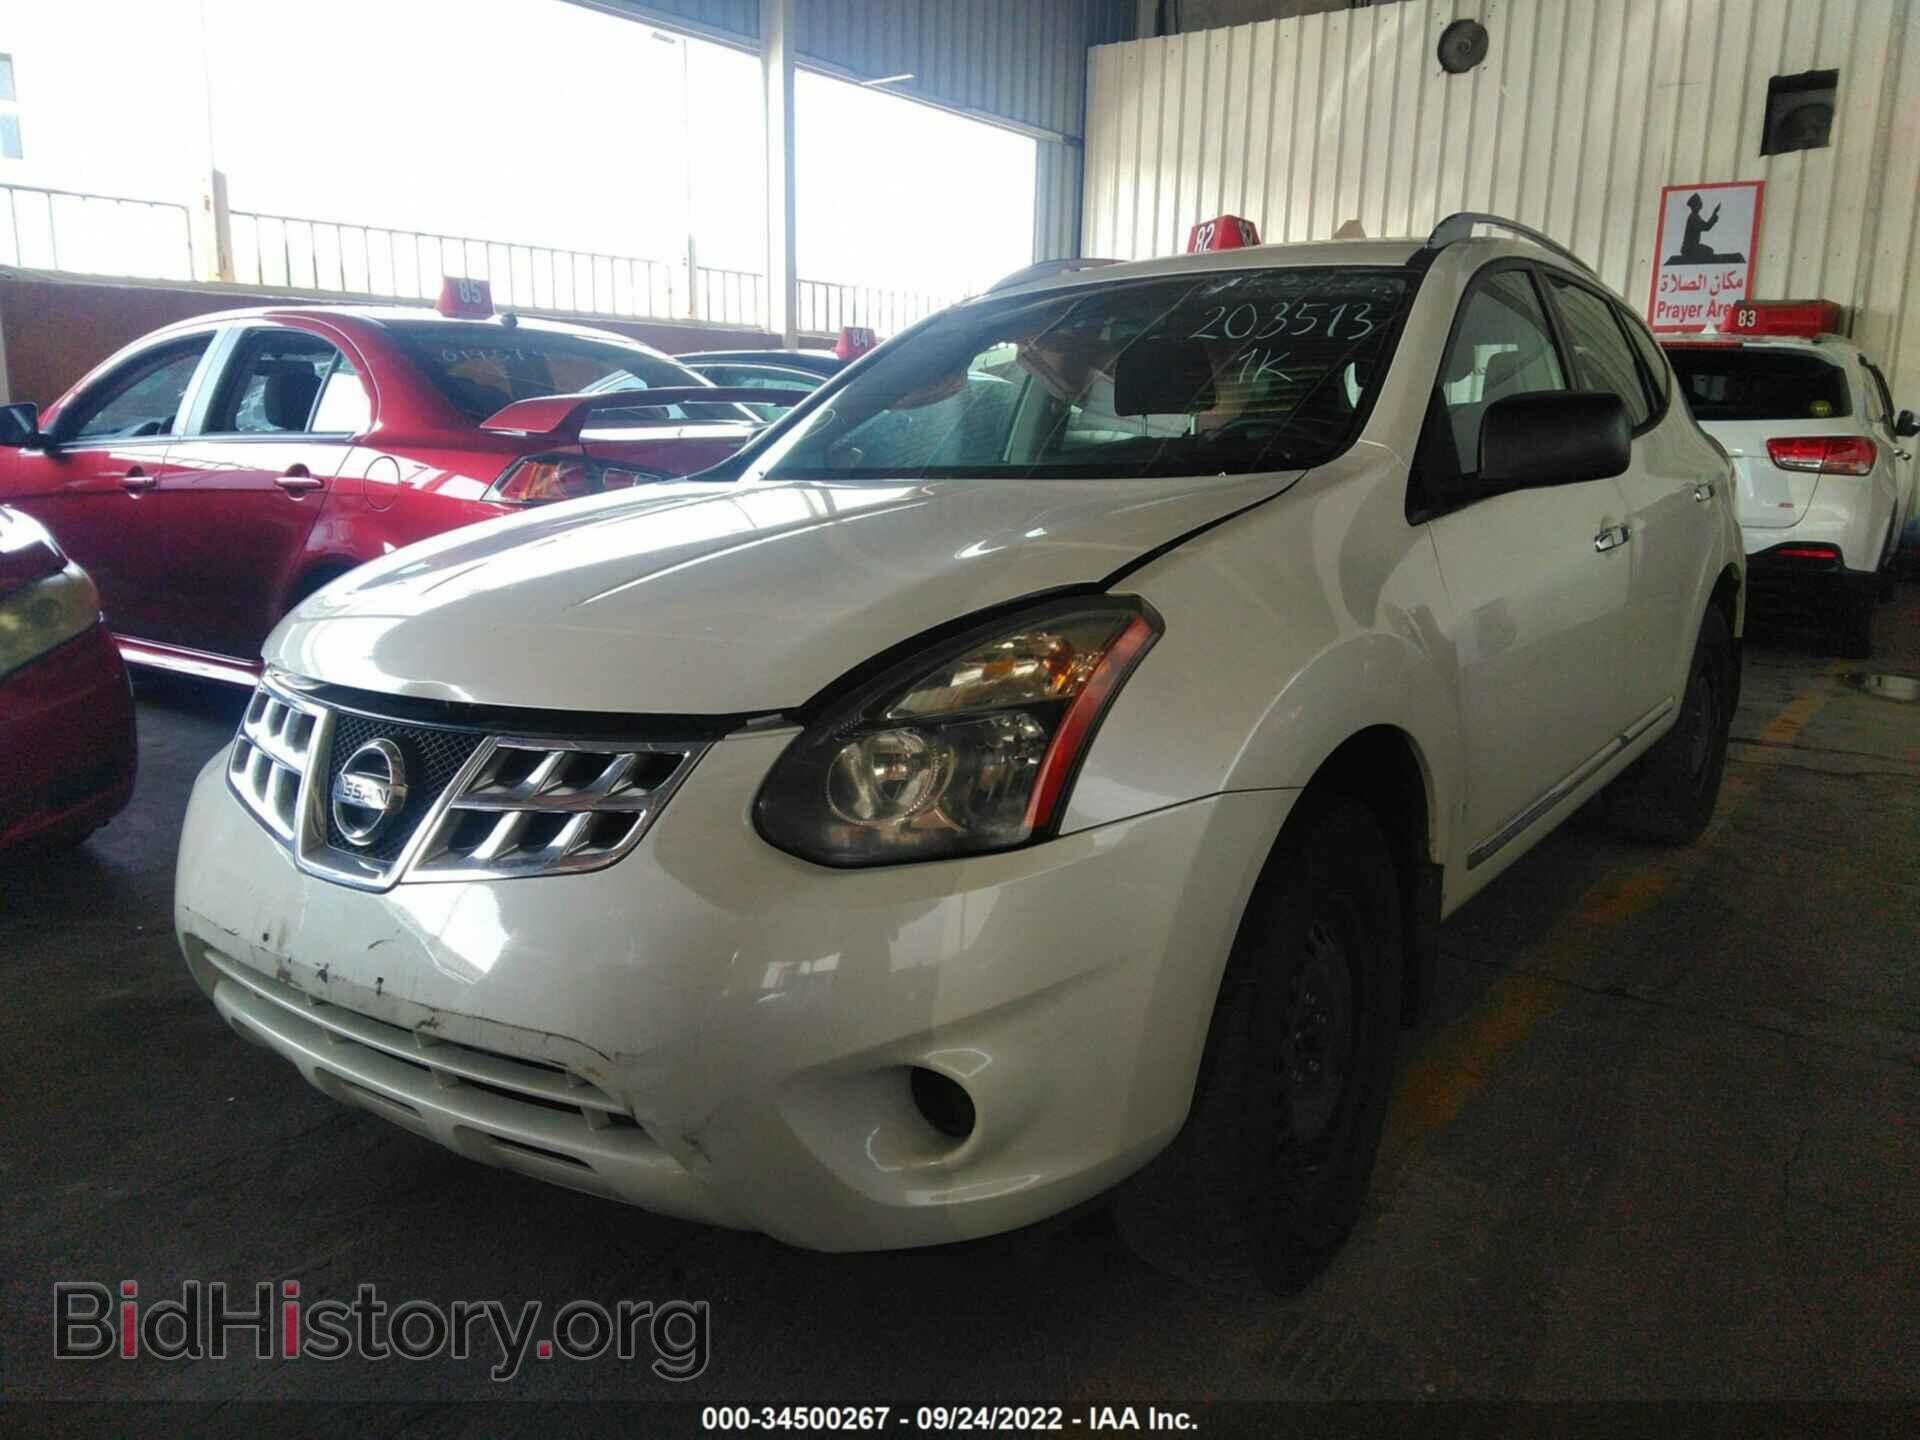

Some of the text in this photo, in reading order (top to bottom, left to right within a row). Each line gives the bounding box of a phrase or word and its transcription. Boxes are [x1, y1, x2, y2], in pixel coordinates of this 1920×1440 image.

[1194, 222, 1215, 253] 82
[1660, 269, 1744, 296] مكان الصلاة
[1188, 302, 1374, 340] 203513
[1656, 299, 1734, 323] Prayer Are
[1738, 309, 1757, 328] 83
